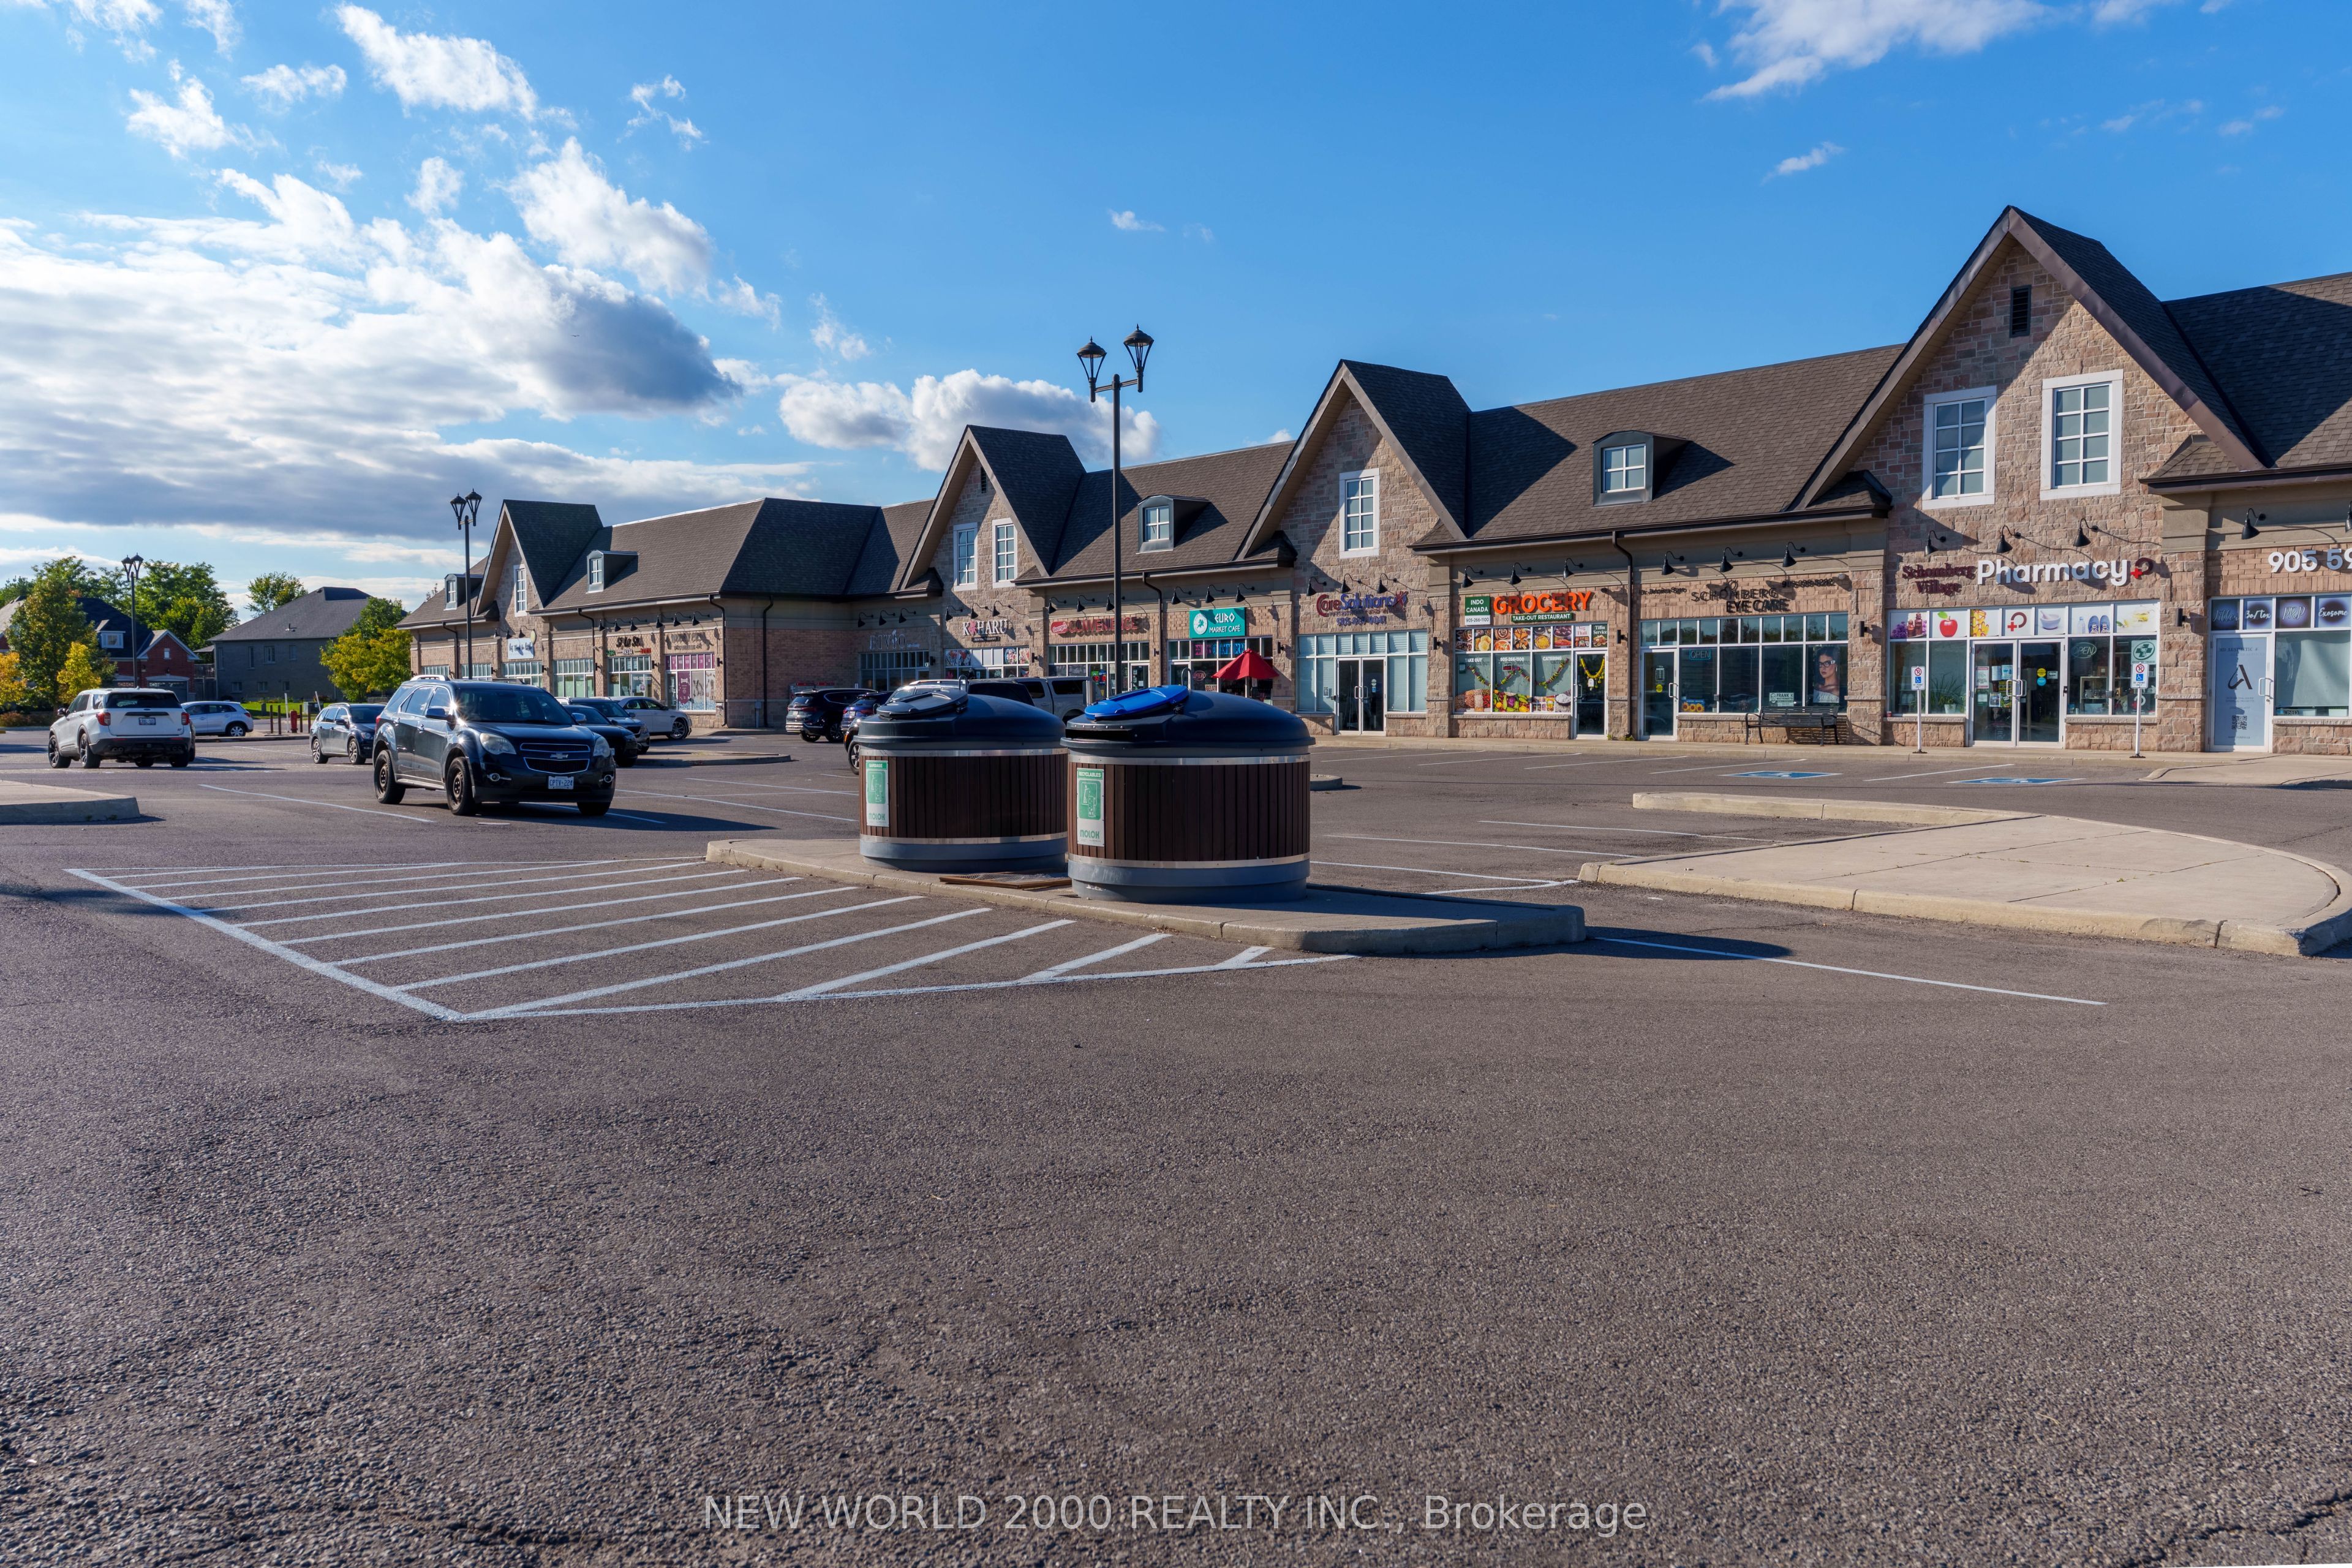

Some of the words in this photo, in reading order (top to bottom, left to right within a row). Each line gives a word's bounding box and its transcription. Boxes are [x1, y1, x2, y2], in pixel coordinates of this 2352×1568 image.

[2268, 549, 2318, 573] 905
[1902, 563, 1977, 579] Schomberg
[1978, 559, 2127, 586] Pharmacy
[1691, 588, 1779, 601] SCHOMBERG
[1915, 579, 1962, 596] Village
[1493, 591, 1591, 614] GROCERY
[1727, 601, 1752, 612] EYE
[1753, 598, 1791, 612] CARE
[1215, 612, 1235, 623] EURO
[2318, 607, 2348, 617] Exosome
[1069, 617, 1139, 633] CONVENIECE
[1080, 829, 1099, 839] MOLOK
